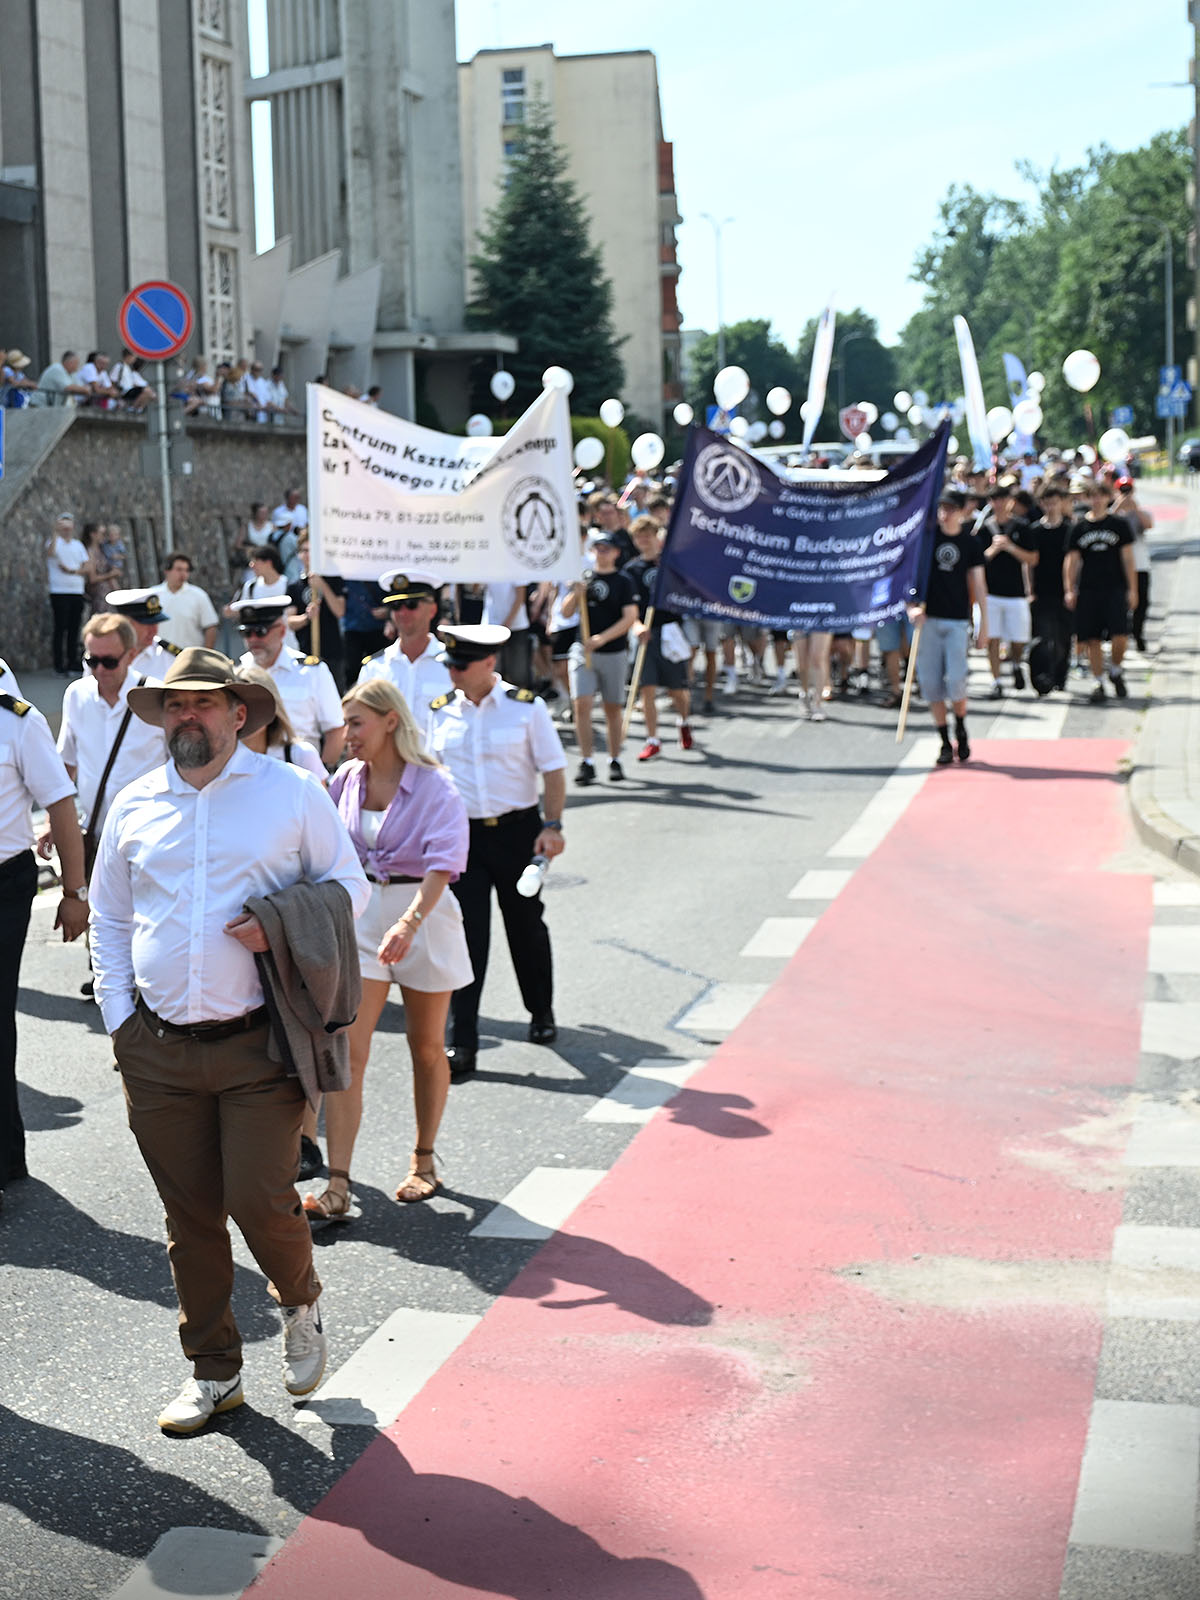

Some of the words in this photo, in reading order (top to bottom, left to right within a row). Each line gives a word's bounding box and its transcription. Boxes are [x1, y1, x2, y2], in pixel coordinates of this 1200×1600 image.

[343, 461, 350, 476] 1
[443, 513, 486, 527] Gdynia
[689, 506, 791, 550] Technikum
[794, 535, 871, 555] Budowy
